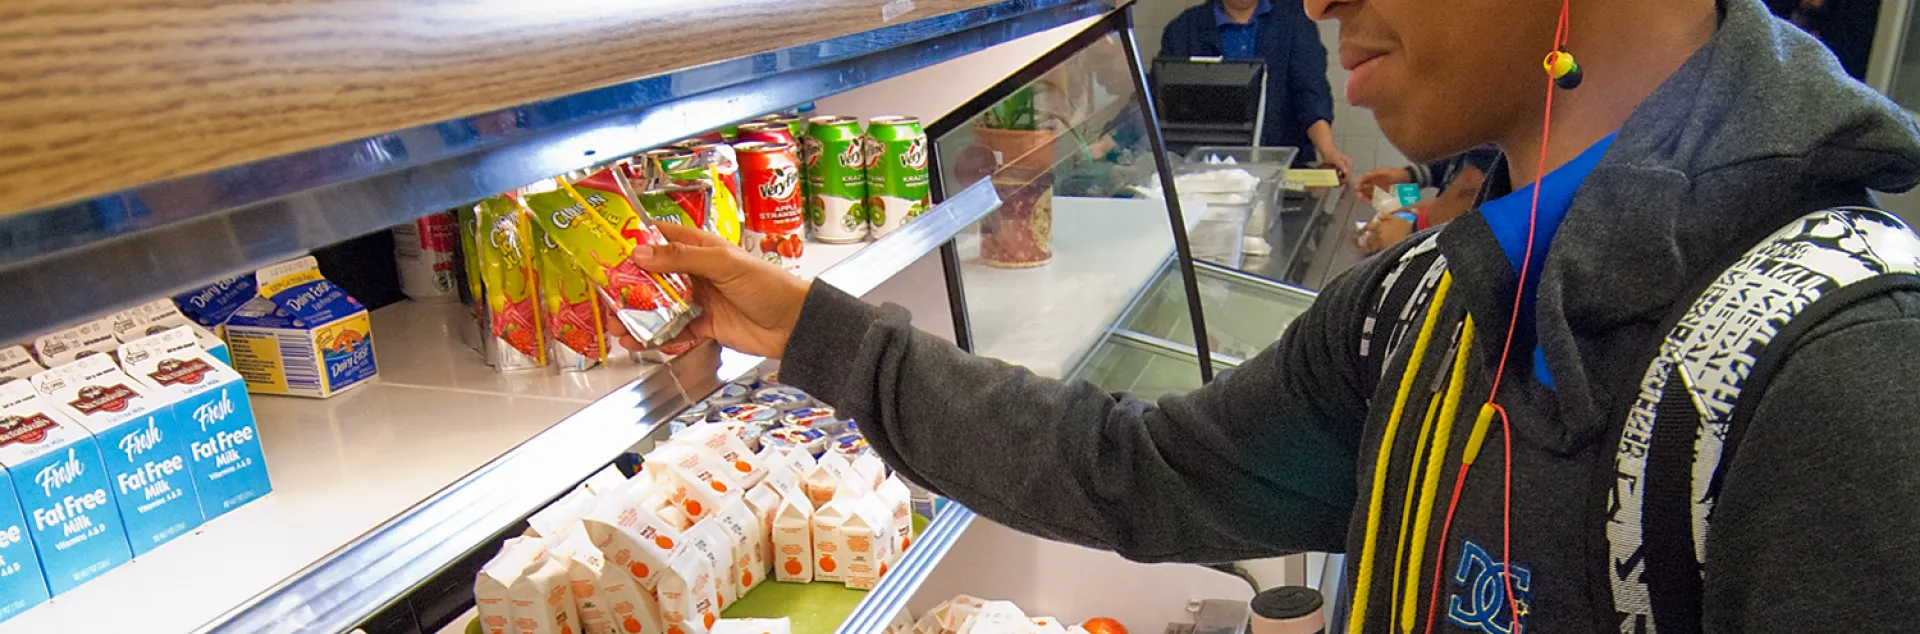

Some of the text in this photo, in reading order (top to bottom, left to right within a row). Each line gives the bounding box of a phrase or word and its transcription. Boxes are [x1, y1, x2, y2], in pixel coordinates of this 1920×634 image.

[286, 281, 332, 312] Dairy Ease
[331, 357, 353, 378] Dairy
[353, 346, 369, 365] Ease
[192, 388, 235, 432] Fresh
[118, 416, 163, 463] Fresh
[191, 425, 253, 462] Fat Free
[35, 448, 84, 498] Fresh
[215, 448, 241, 468] Milk
[235, 462, 242, 471] A
[245, 457, 252, 466] D
[117, 454, 183, 495] Fat Free
[144, 479, 171, 501] Milk
[33, 488, 107, 532] Fat Free
[166, 493, 173, 501] A
[176, 488, 183, 497] D
[0, 525, 21, 549] ee
[63, 514, 93, 538] Milk
[87, 528, 95, 538] A
[98, 523, 106, 533] D
